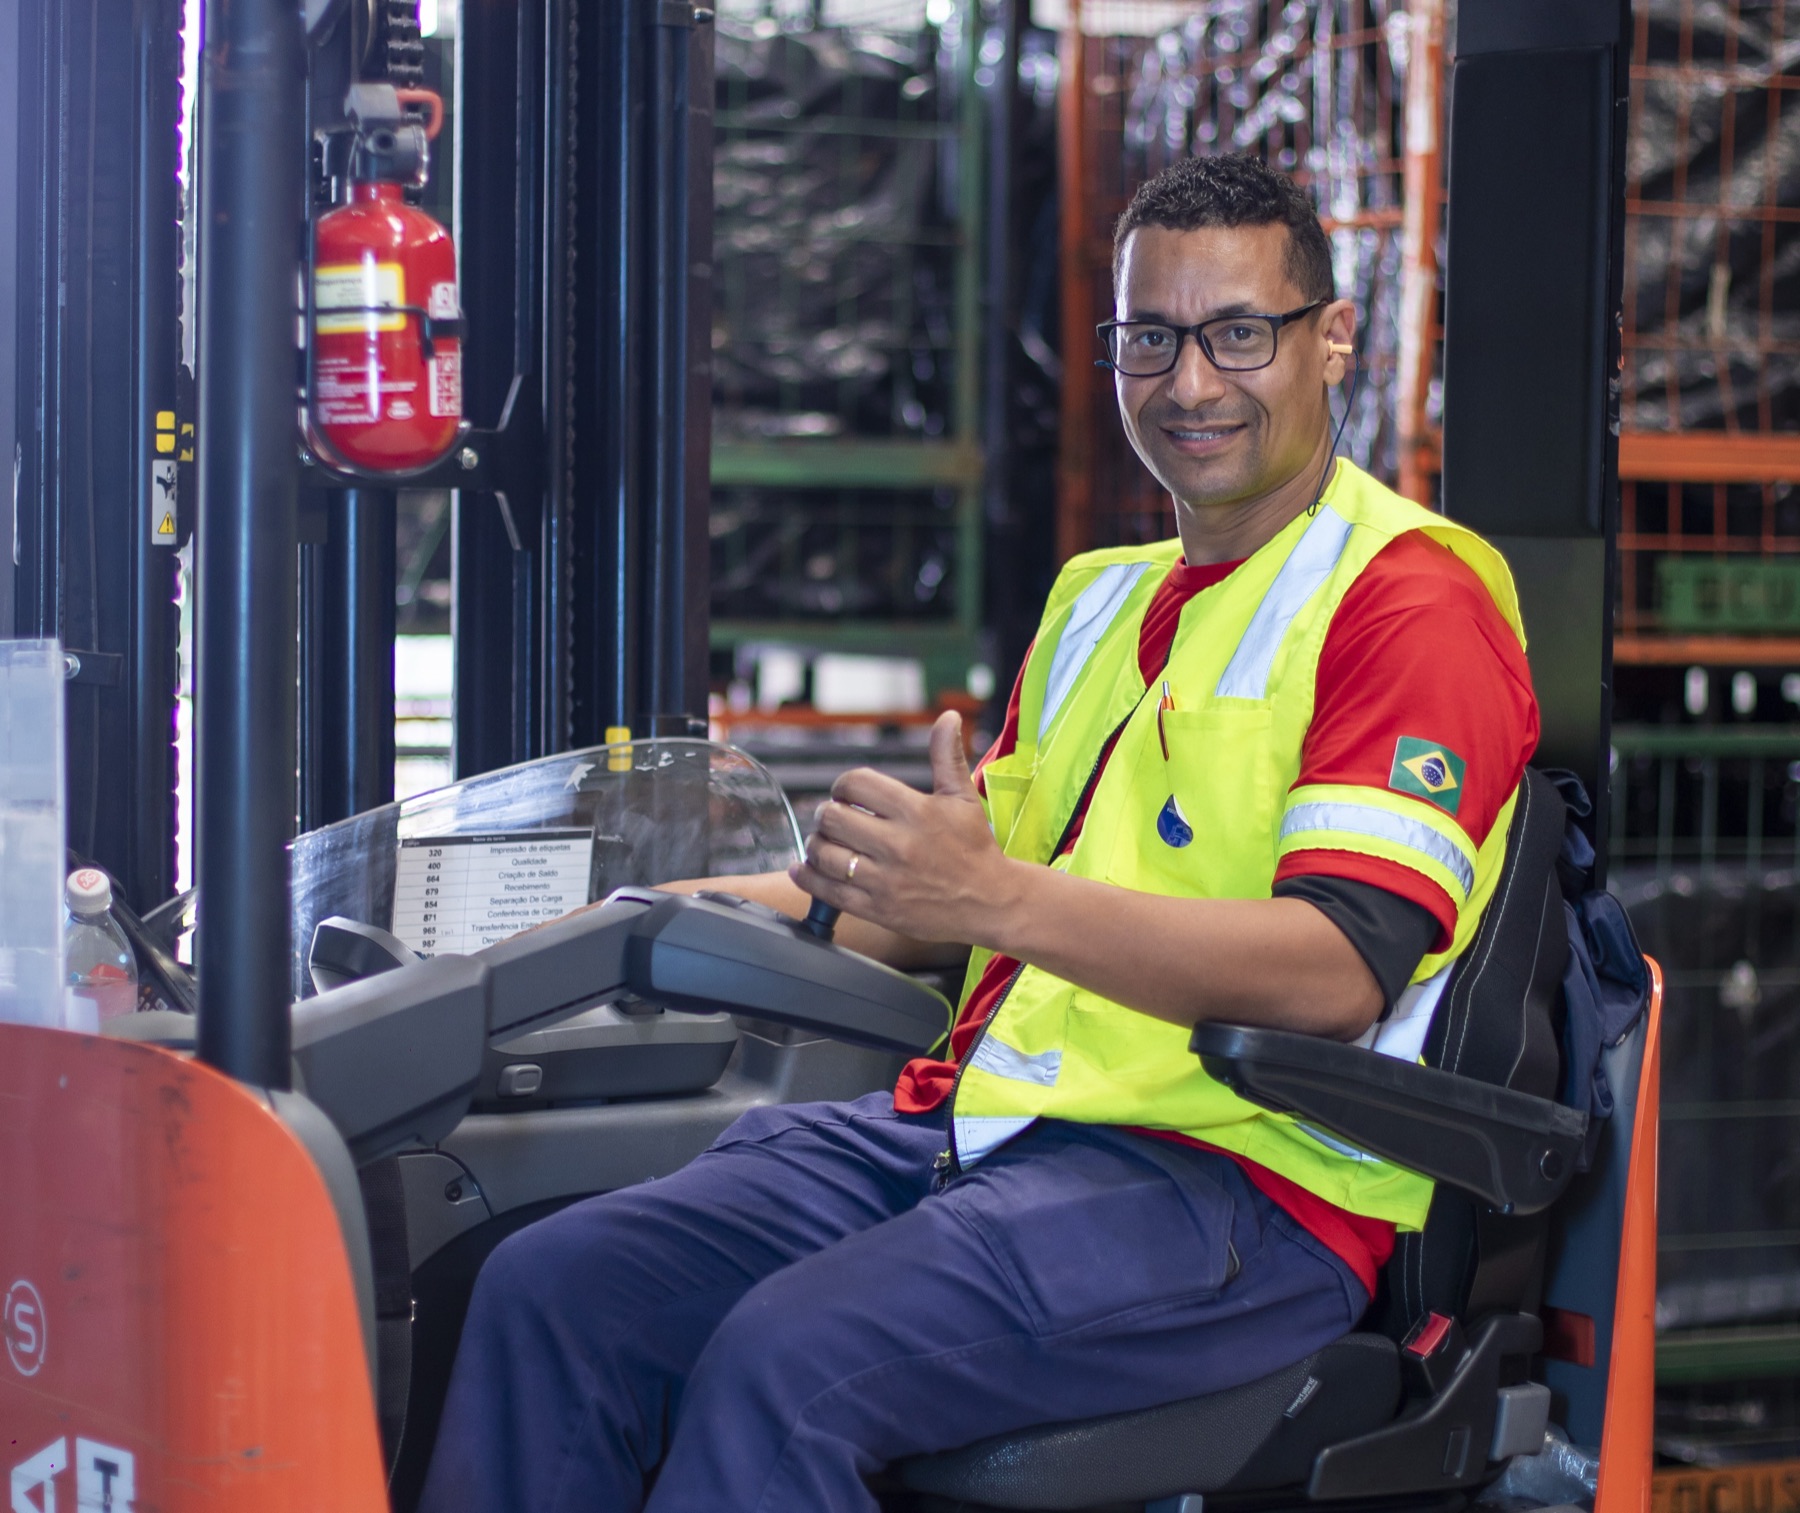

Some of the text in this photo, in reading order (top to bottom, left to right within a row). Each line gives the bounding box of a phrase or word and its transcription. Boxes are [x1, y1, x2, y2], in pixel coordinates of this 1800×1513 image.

[428, 849, 442, 857] 320
[490, 845, 527, 855] Impressão
[539, 844, 571, 854] etiquetas
[511, 857, 548, 866] Qualidade
[427, 862, 441, 870] 400
[498, 869, 558, 880] Criação de Saldo
[426, 875, 440, 883] 664
[504, 883, 551, 892] Recebimento
[425, 888, 439, 896] 679
[489, 895, 563, 906] Separação De Carga
[424, 901, 438, 909] 854
[487, 908, 564, 919] Conferência de Carga
[423, 914, 437, 922] 871
[471, 921, 538, 932] Transferência Ent
[423, 927, 437, 935] 965
[422, 940, 436, 948] 987
